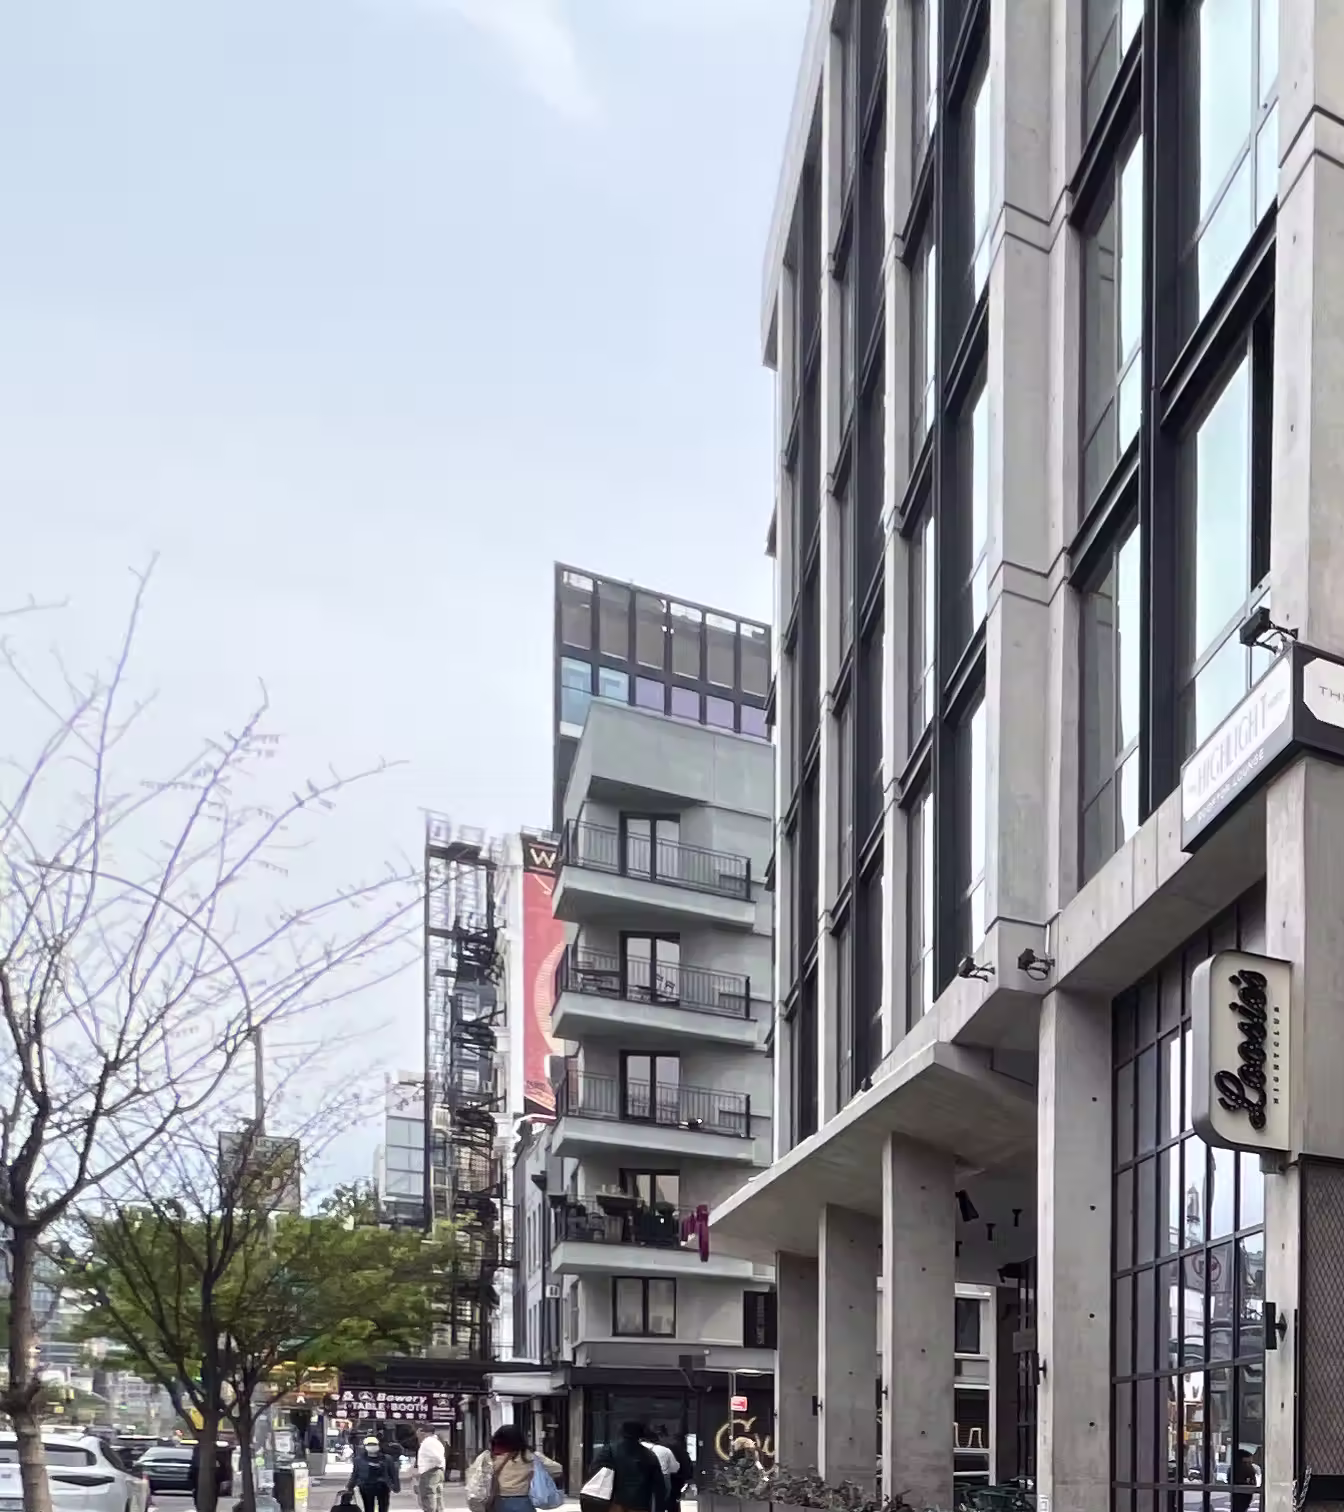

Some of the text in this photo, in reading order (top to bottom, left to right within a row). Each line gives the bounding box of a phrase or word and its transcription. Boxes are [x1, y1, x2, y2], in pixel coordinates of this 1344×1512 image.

[1272, 1005, 1280, 1105] NIGHTCLUB
[376, 1392, 427, 1404] Bowery
[352, 1401, 386, 1411] TABLE
[391, 1402, 428, 1412] BOOTH
